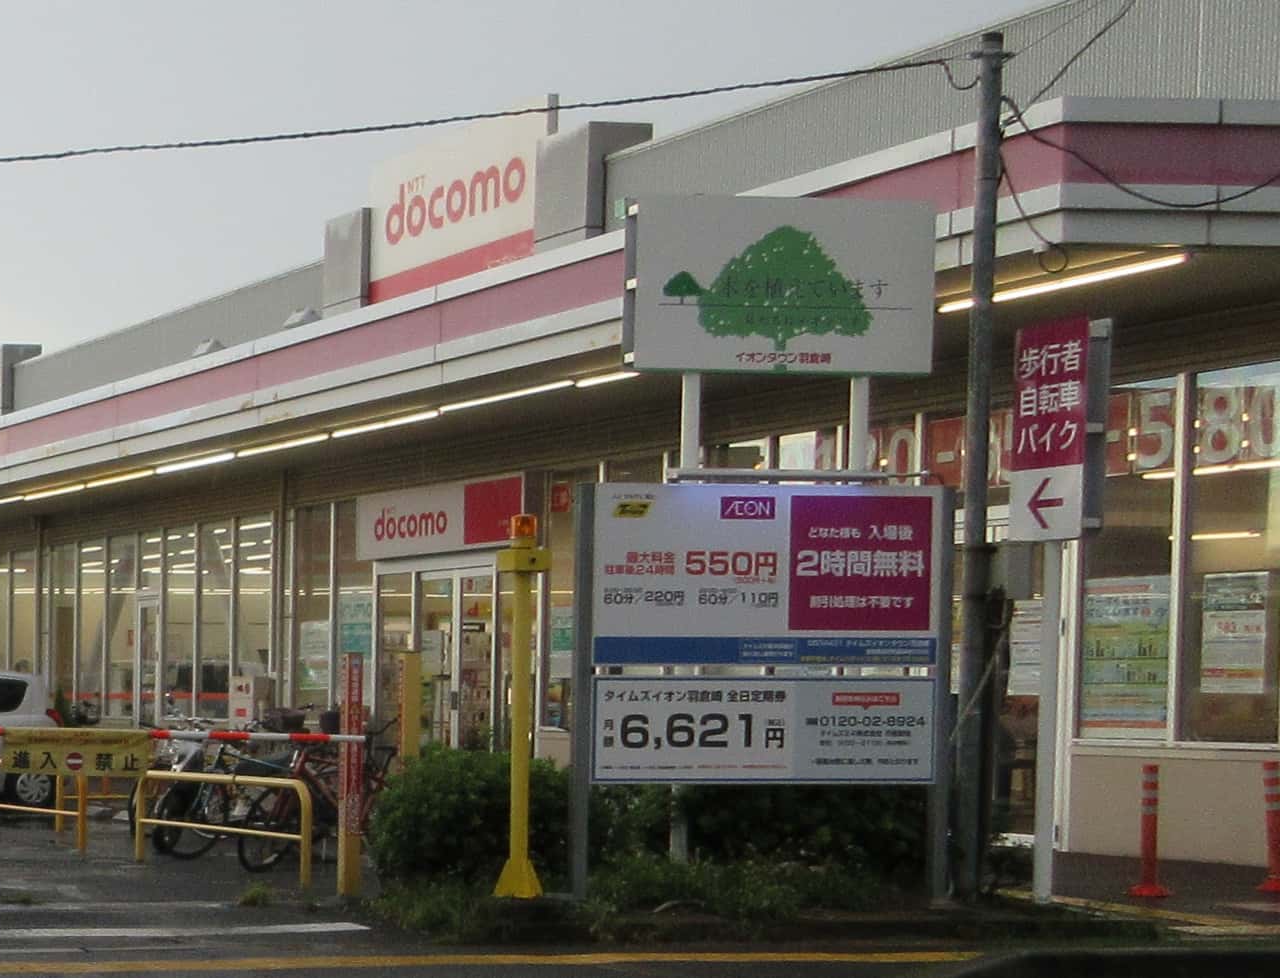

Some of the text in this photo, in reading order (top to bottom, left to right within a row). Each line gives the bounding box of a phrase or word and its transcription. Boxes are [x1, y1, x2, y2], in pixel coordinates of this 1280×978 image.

[385, 156, 526, 246] docomo
[1018, 340, 1082, 378] 歩行者
[1018, 381, 1082, 418] 自転車
[1017, 420, 1080, 455] バイク
[724, 501, 771, 516] AEON
[374, 507, 448, 542] docomo
[868, 525, 913, 541] 入場後
[625, 551, 676, 564] 最大料金
[685, 551, 778, 577] 550円
[795, 550, 925, 577] 2時間無料
[603, 690, 723, 703] タイムズイオン羽倉崎
